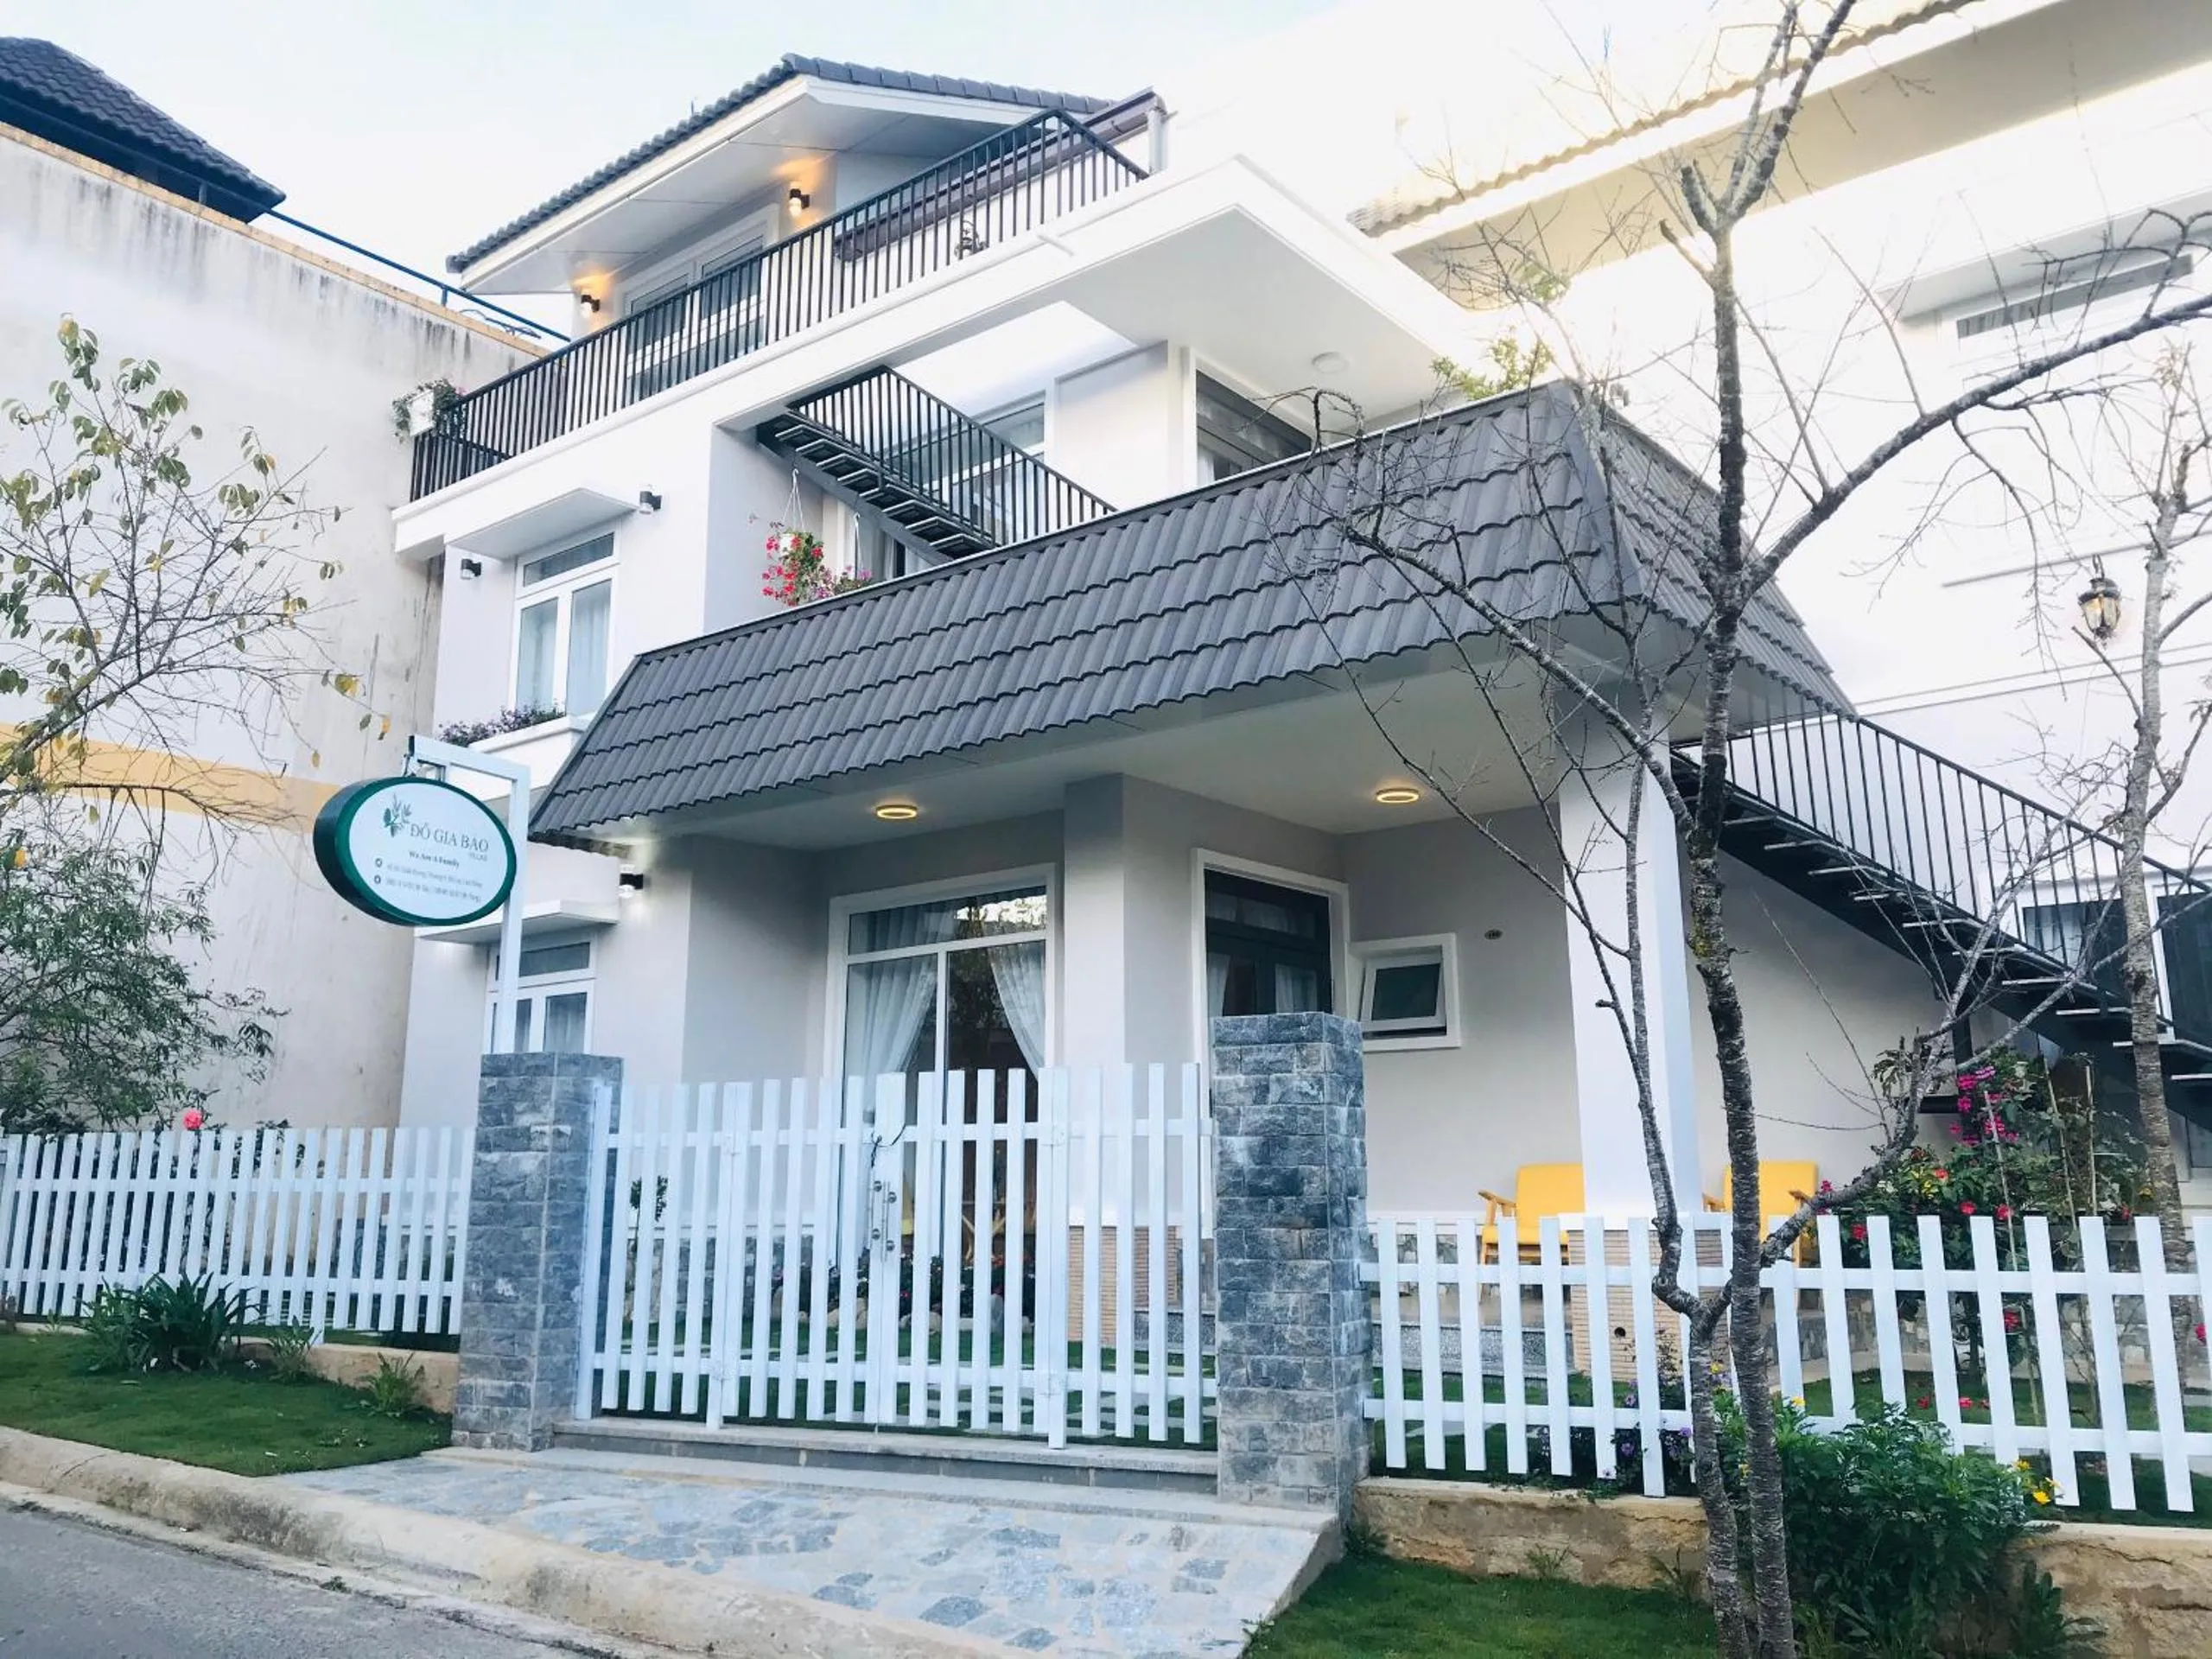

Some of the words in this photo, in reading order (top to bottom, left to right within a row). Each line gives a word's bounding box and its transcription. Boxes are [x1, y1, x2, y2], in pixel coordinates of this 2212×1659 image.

[434, 829, 457, 846] GIA
[409, 850, 420, 859] We
[421, 853, 431, 861] Are
[439, 855, 460, 868] Family
